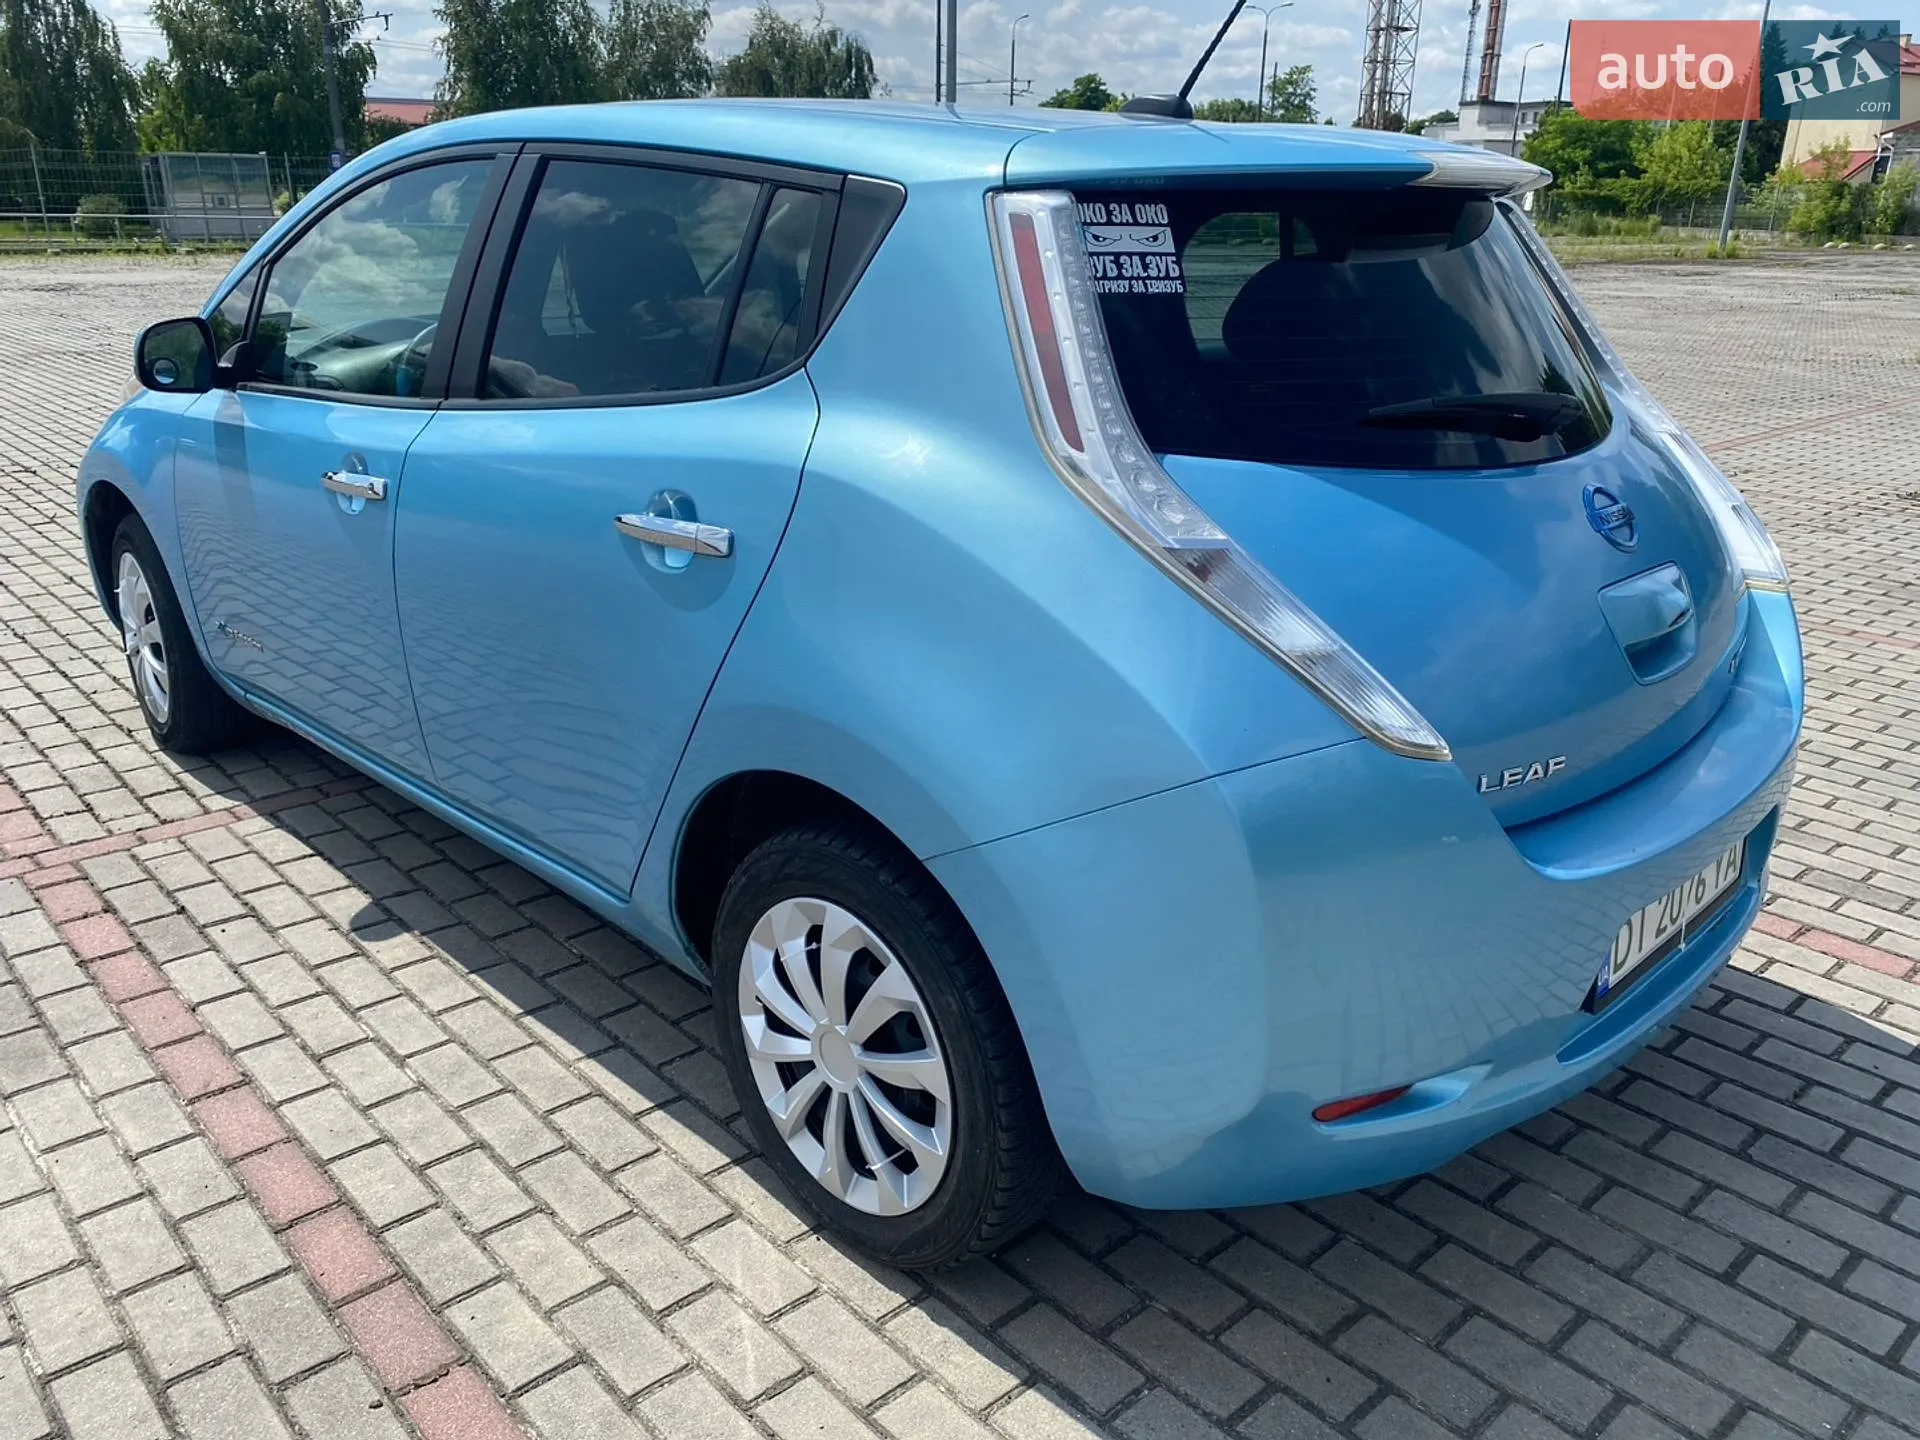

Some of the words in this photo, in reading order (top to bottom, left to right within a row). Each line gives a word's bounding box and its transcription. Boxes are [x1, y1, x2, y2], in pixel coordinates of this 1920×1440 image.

[1109, 203, 1134, 223] ЗА
[1135, 203, 1169, 224] ОКО
[1146, 255, 1180, 278] ЗУБ
[1131, 280, 1146, 293] ЗА
[1478, 755, 1566, 793] LEAF
